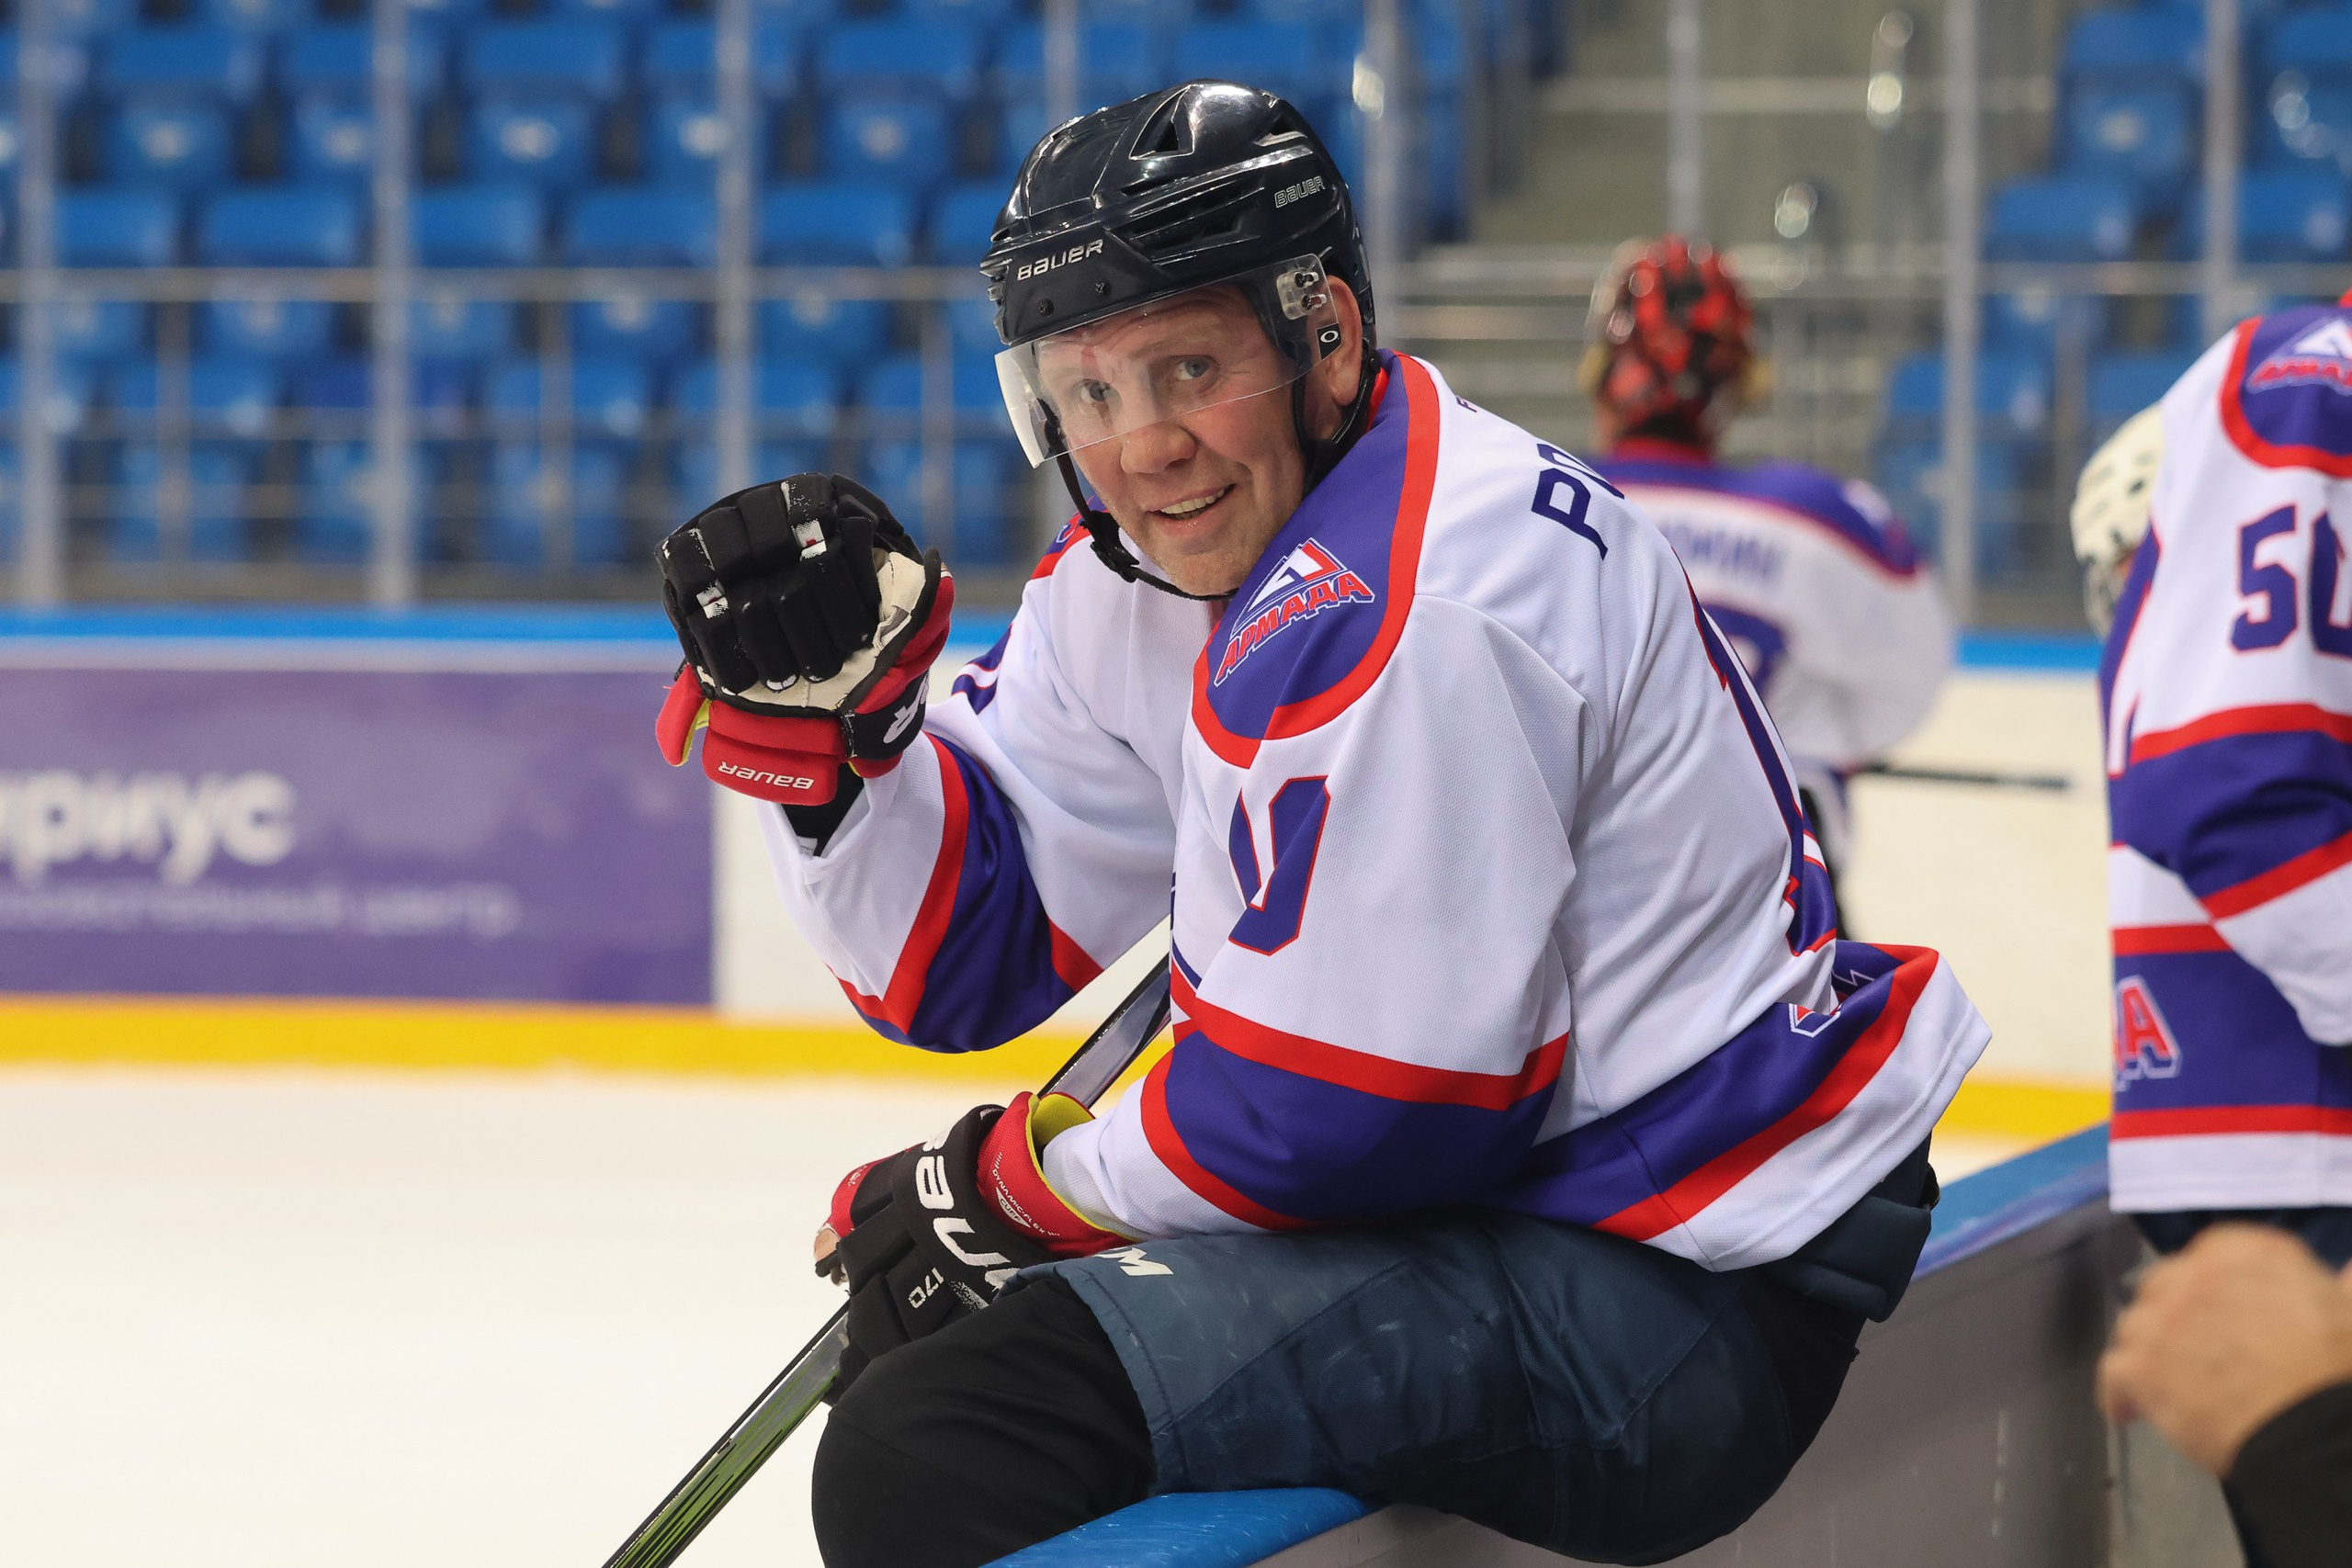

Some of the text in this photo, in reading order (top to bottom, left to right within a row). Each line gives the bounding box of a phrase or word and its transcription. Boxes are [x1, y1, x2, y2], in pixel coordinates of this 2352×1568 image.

[1273, 175, 1325, 209] BAUER
[1016, 239, 1103, 281] BAUER
[1214, 570, 1375, 687] АРМАДА
[718, 761, 815, 790] BAUER
[908, 1268, 944, 1309] 170
